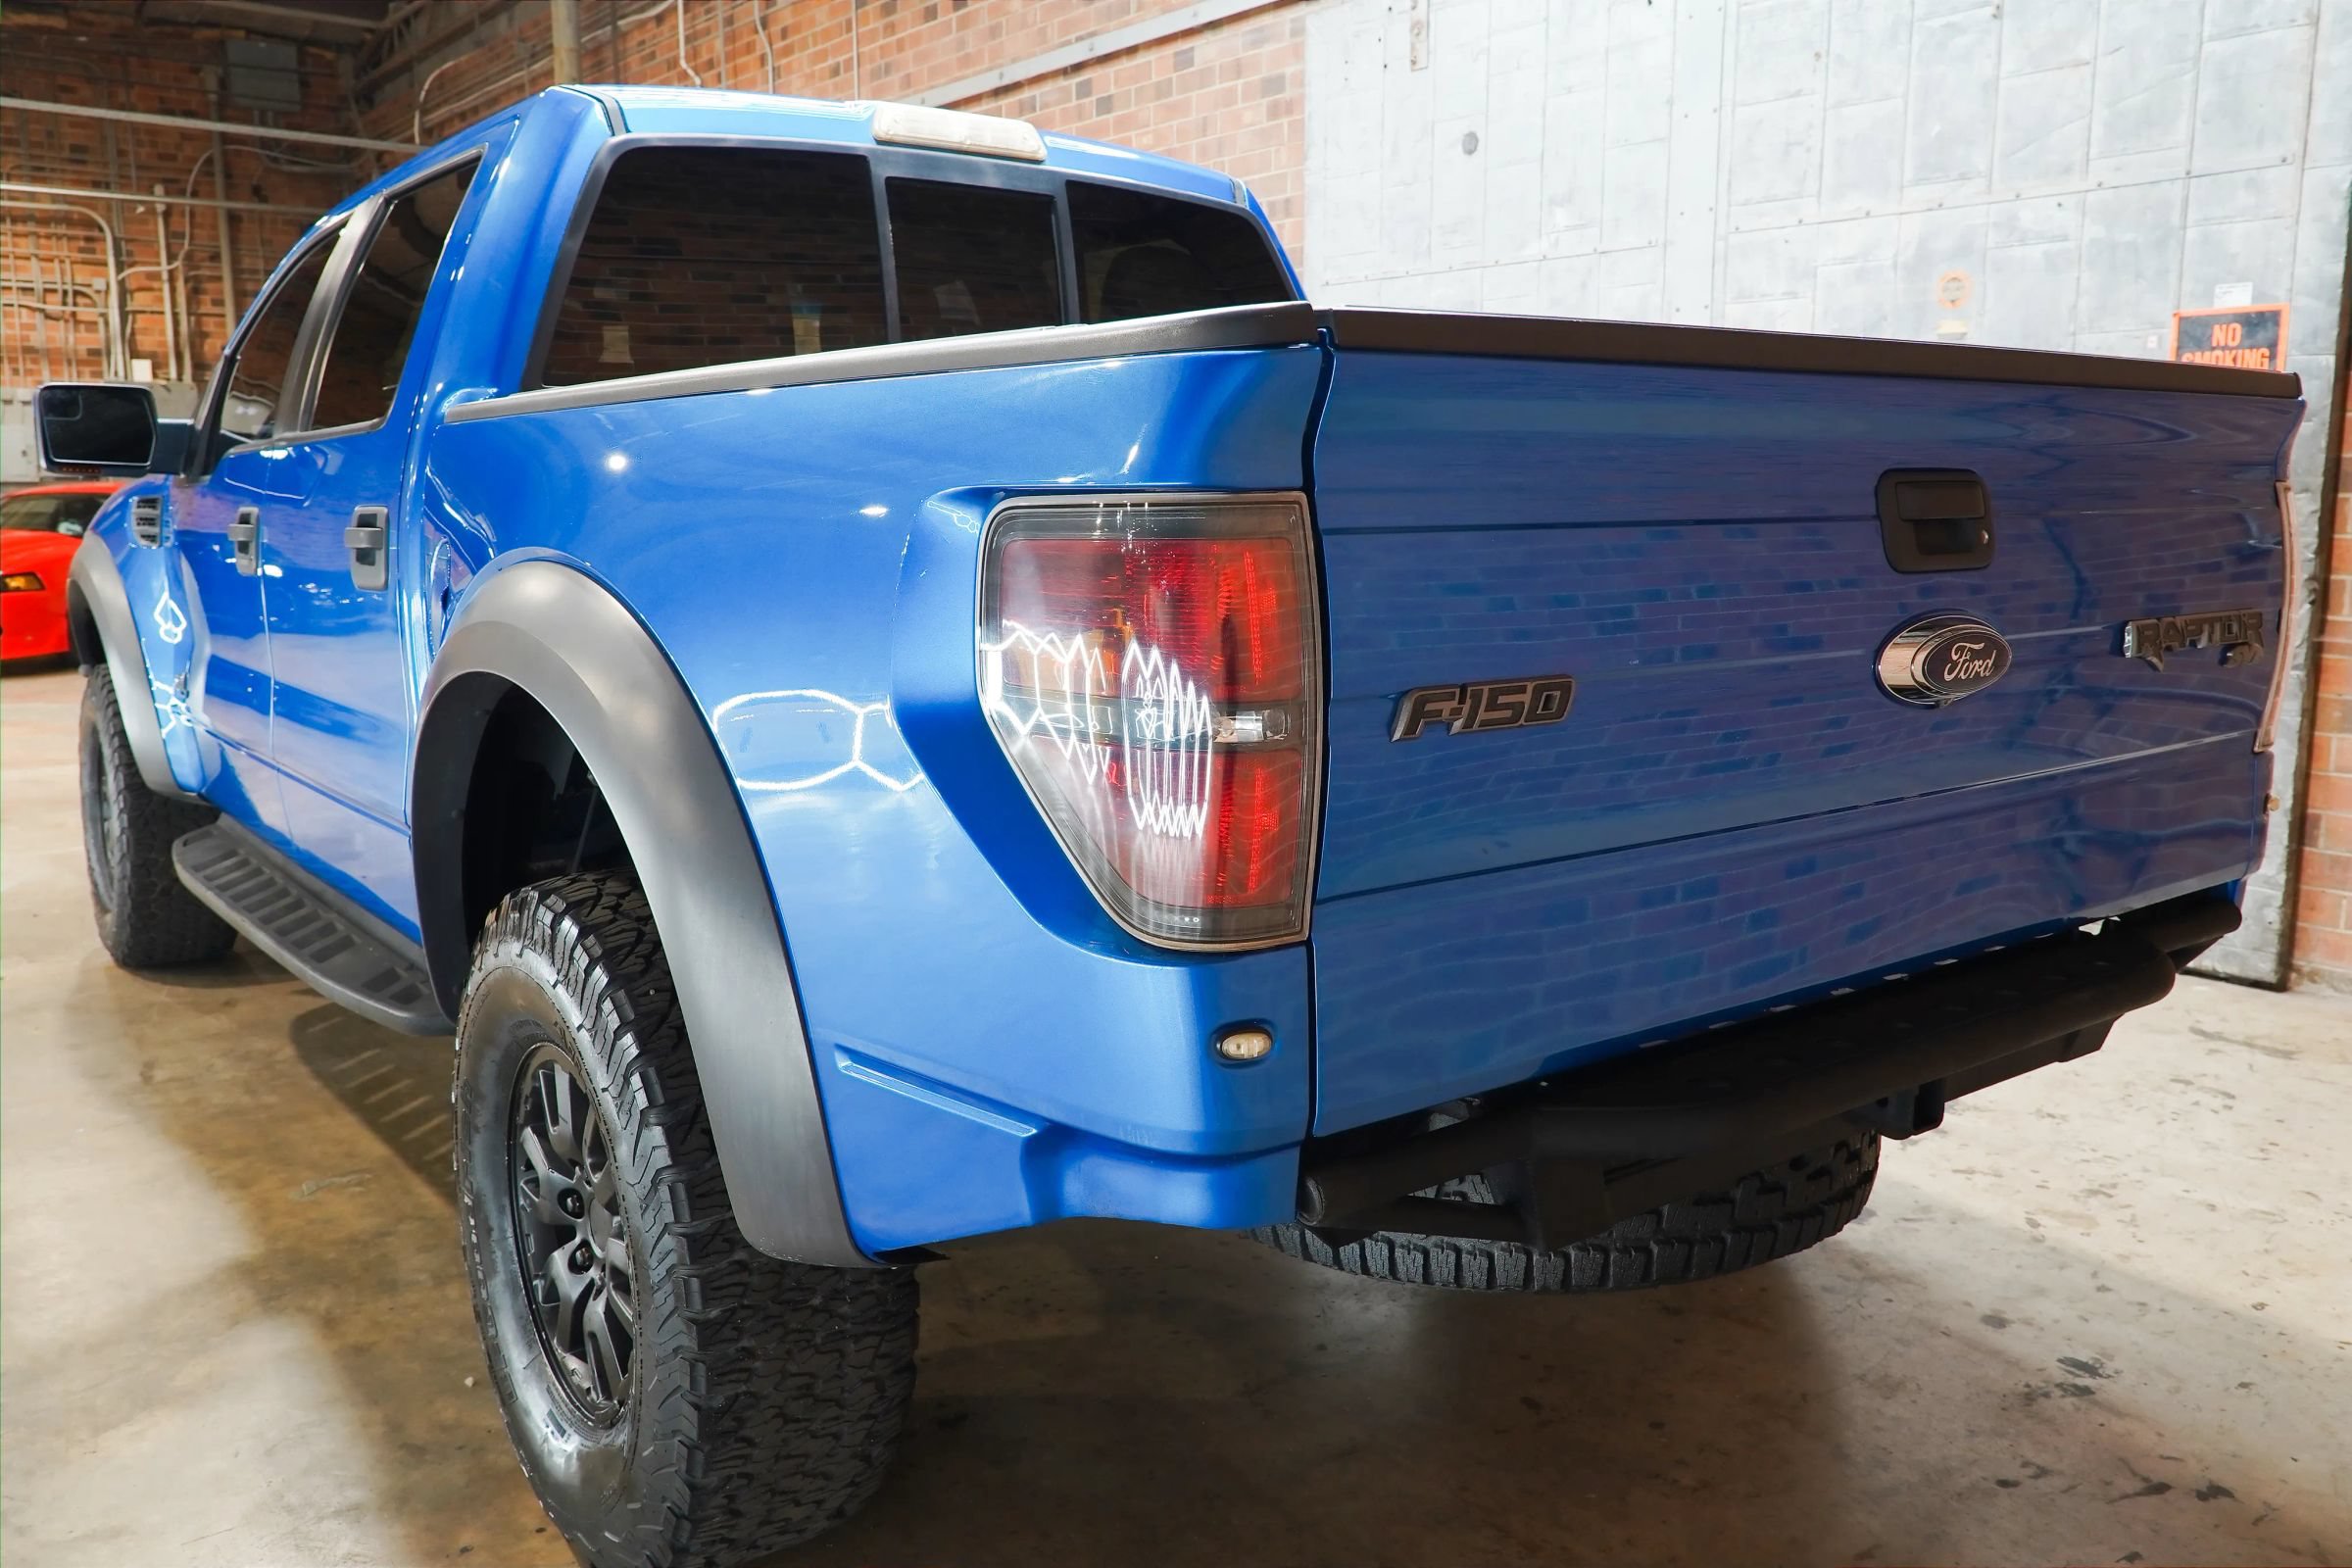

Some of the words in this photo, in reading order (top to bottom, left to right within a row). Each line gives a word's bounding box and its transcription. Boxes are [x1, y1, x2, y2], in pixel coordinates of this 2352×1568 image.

[2212, 322, 2242, 347] NO
[1943, 642, 1997, 682] Ford
[2125, 609, 2264, 672] RAPTOR
[1390, 674, 1575, 742] F-150
